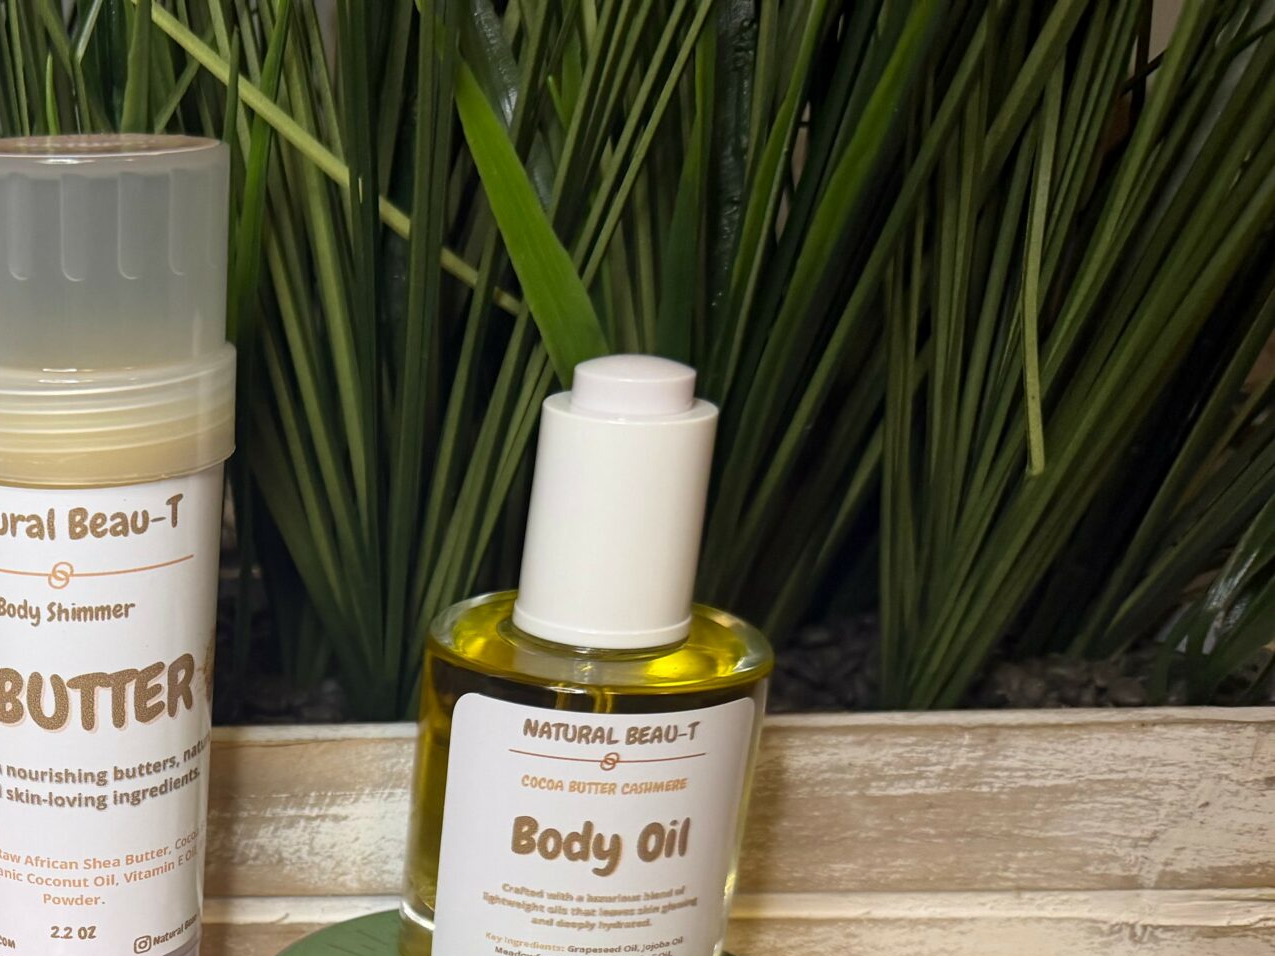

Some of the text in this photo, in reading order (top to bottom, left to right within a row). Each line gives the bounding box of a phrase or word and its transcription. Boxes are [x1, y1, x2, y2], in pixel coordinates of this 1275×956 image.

[68, 493, 183, 541] Beau-T
[46, 601, 136, 623] Shimmer
[523, 718, 701, 746] NATURAL BEAU-T
[6, 766, 108, 787] nourishing
[113, 755, 180, 782] butters,
[6, 787, 108, 811] skin-loving
[113, 769, 201, 807] ingredients.
[521, 774, 689, 796] COCOA BUTTER CASHMERE
[24, 855, 79, 871] African
[83, 857, 121, 871] Shea
[125, 846, 171, 866] Butter,
[510, 815, 691, 877] Body Oil
[27, 873, 89, 888] Coconut
[93, 874, 119, 888] Oil,
[124, 860, 175, 883] Vitamin
[43, 893, 106, 906] Powder.
[50, 925, 97, 940] 2.2 OZ
[153, 924, 183, 946] Natural
[567, 943, 623, 956] Grapeseed
